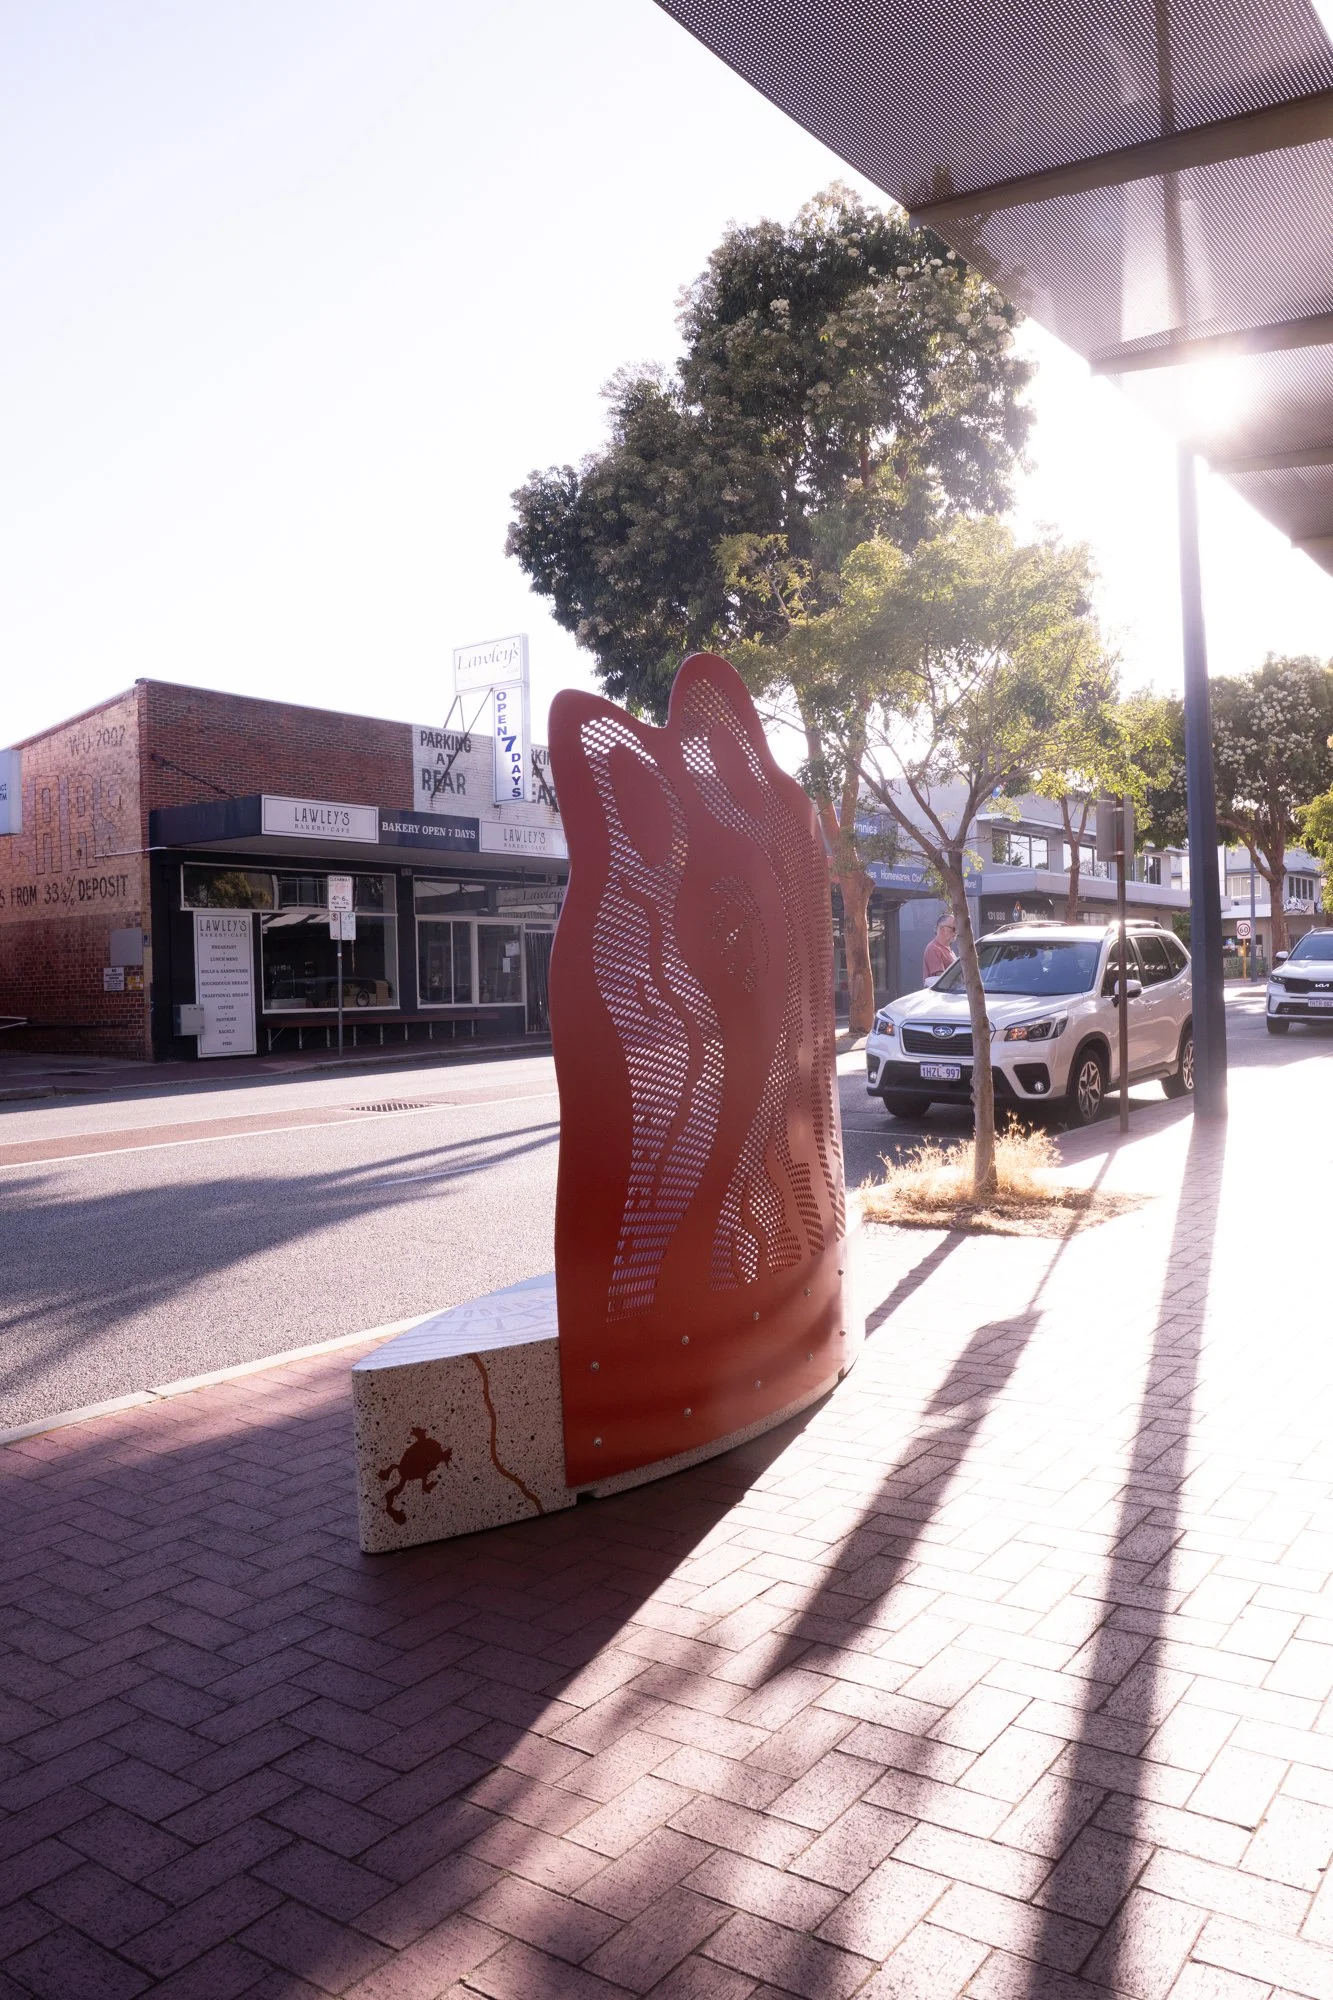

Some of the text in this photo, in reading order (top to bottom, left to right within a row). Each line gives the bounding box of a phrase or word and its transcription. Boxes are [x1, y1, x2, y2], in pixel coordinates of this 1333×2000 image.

[420, 730, 472, 753] PARKING
[497, 692, 521, 797] OPEN 7 DAYS
[436, 753, 454, 765] AT
[422, 768, 466, 795] REAR
[294, 808, 350, 825] LAWLEY'S
[382, 822, 476, 839] BAKERY OPEN 7 DAYS
[504, 828, 546, 844] LAWLEY'S
[11, 885, 37, 907] FROM
[79, 875, 128, 901] DEPOSIT
[200, 920, 247, 931] LAWLEY'S
